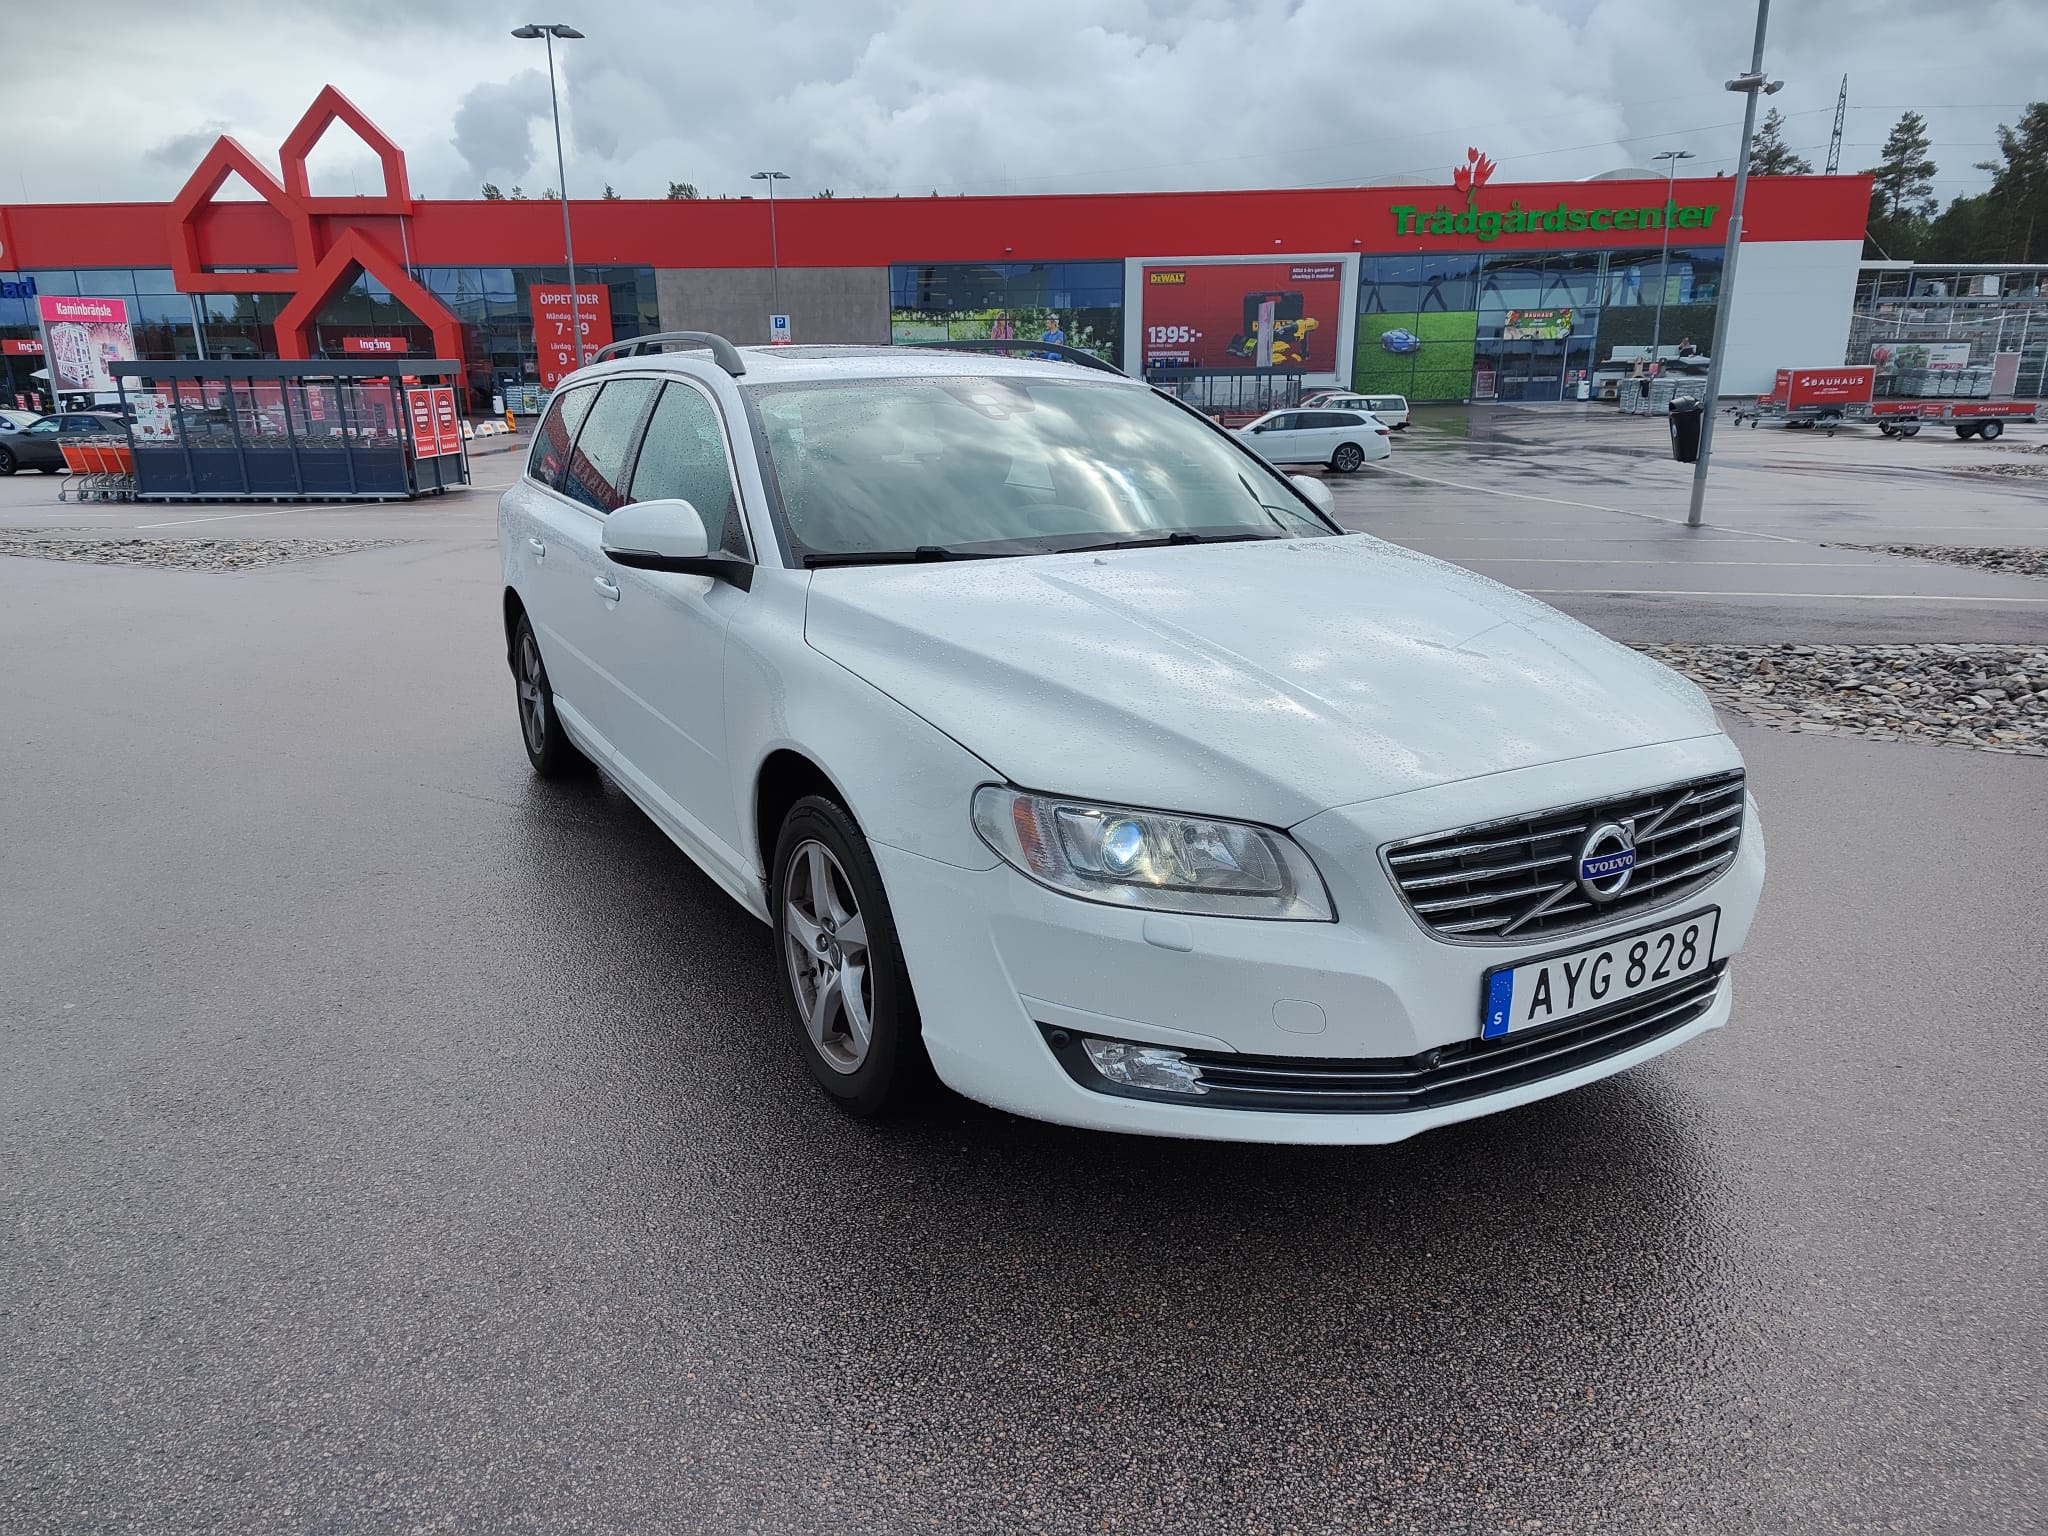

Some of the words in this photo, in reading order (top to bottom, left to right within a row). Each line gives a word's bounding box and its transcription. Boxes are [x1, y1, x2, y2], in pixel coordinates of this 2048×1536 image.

[1390, 199, 1720, 241] Trädgårdscenter
[540, 293, 599, 305] ÖPPETIDER
[56, 302, 112, 317] Kaminbränsle
[556, 323, 563, 335] 7
[776, 318, 784, 328] P
[1148, 326, 1203, 343] 1395:-
[18, 341, 43, 352] Ingån
[360, 339, 391, 351] Ingång
[559, 353, 567, 365] 9
[1811, 377, 1865, 386] BAUHAUS
[1585, 854, 1635, 875] VOLVO
[1527, 951, 1614, 1021] AYG
[1624, 924, 1700, 989] 828
[1493, 1010, 1504, 1027] S
